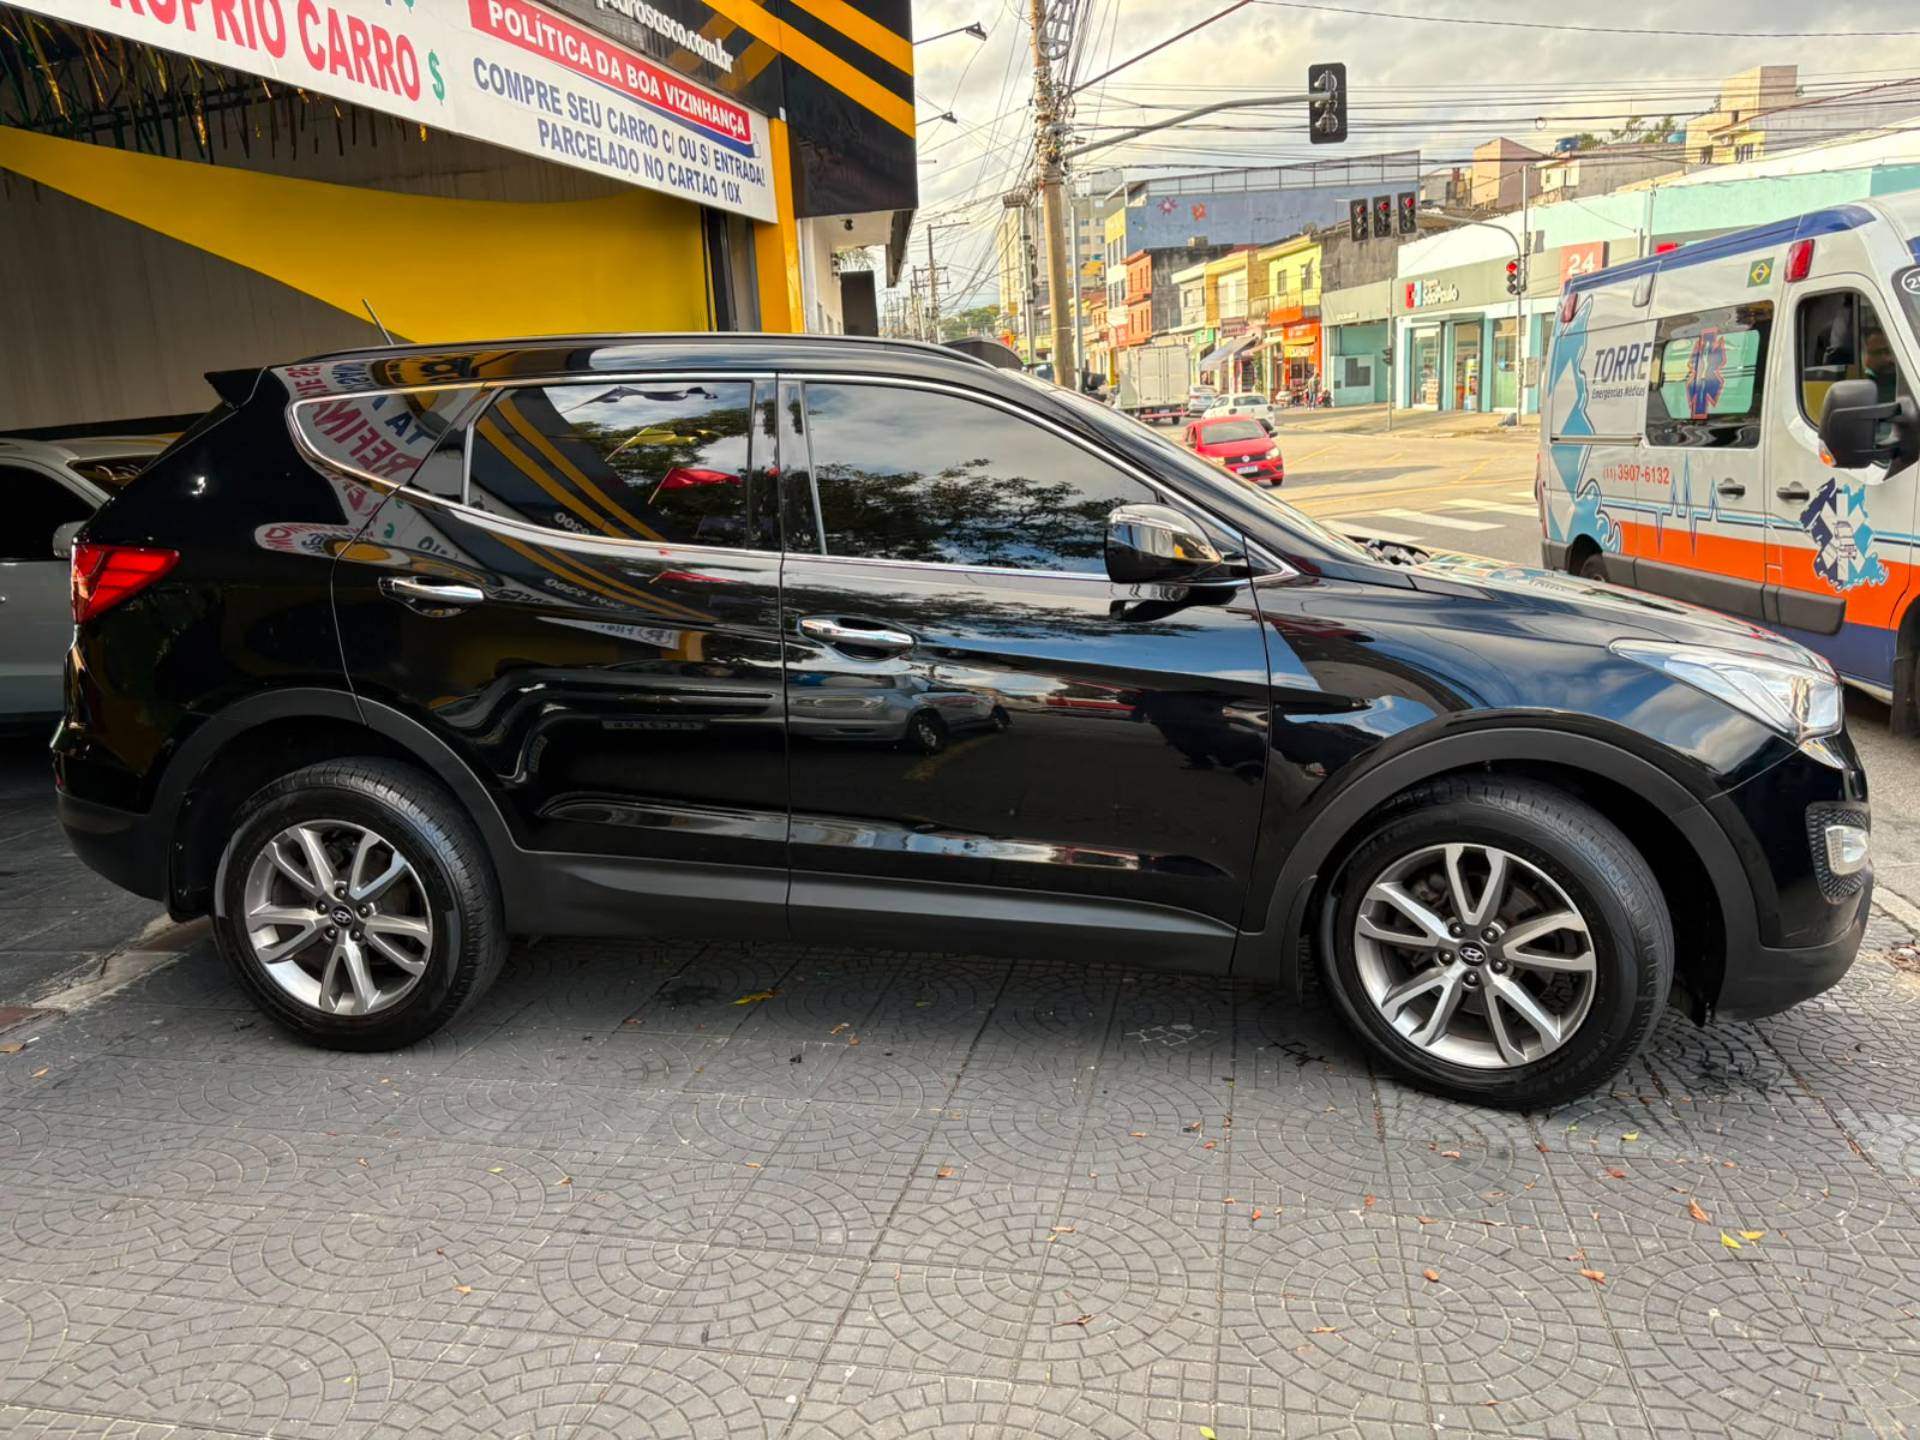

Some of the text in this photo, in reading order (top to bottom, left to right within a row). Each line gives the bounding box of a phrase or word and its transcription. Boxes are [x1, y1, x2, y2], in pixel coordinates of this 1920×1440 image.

[297, 0, 421, 101] CARRO
[488, 0, 747, 137] POLÍTICA DA BOA VIZINHANÇA
[473, 57, 563, 116] COMPRE
[567, 92, 602, 129] SEU
[607, 107, 659, 149] CARRO
[678, 136, 697, 161] OU
[714, 150, 766, 187] ENTRADA!
[537, 118, 639, 174] PARCELADO
[643, 152, 665, 182] NO
[722, 180, 742, 204] 10X
[1567, 252, 1596, 275] 24
[1906, 275, 1920, 289] 2
[1592, 342, 1653, 384] TORRE
[1617, 463, 1671, 484] 3907-6132
